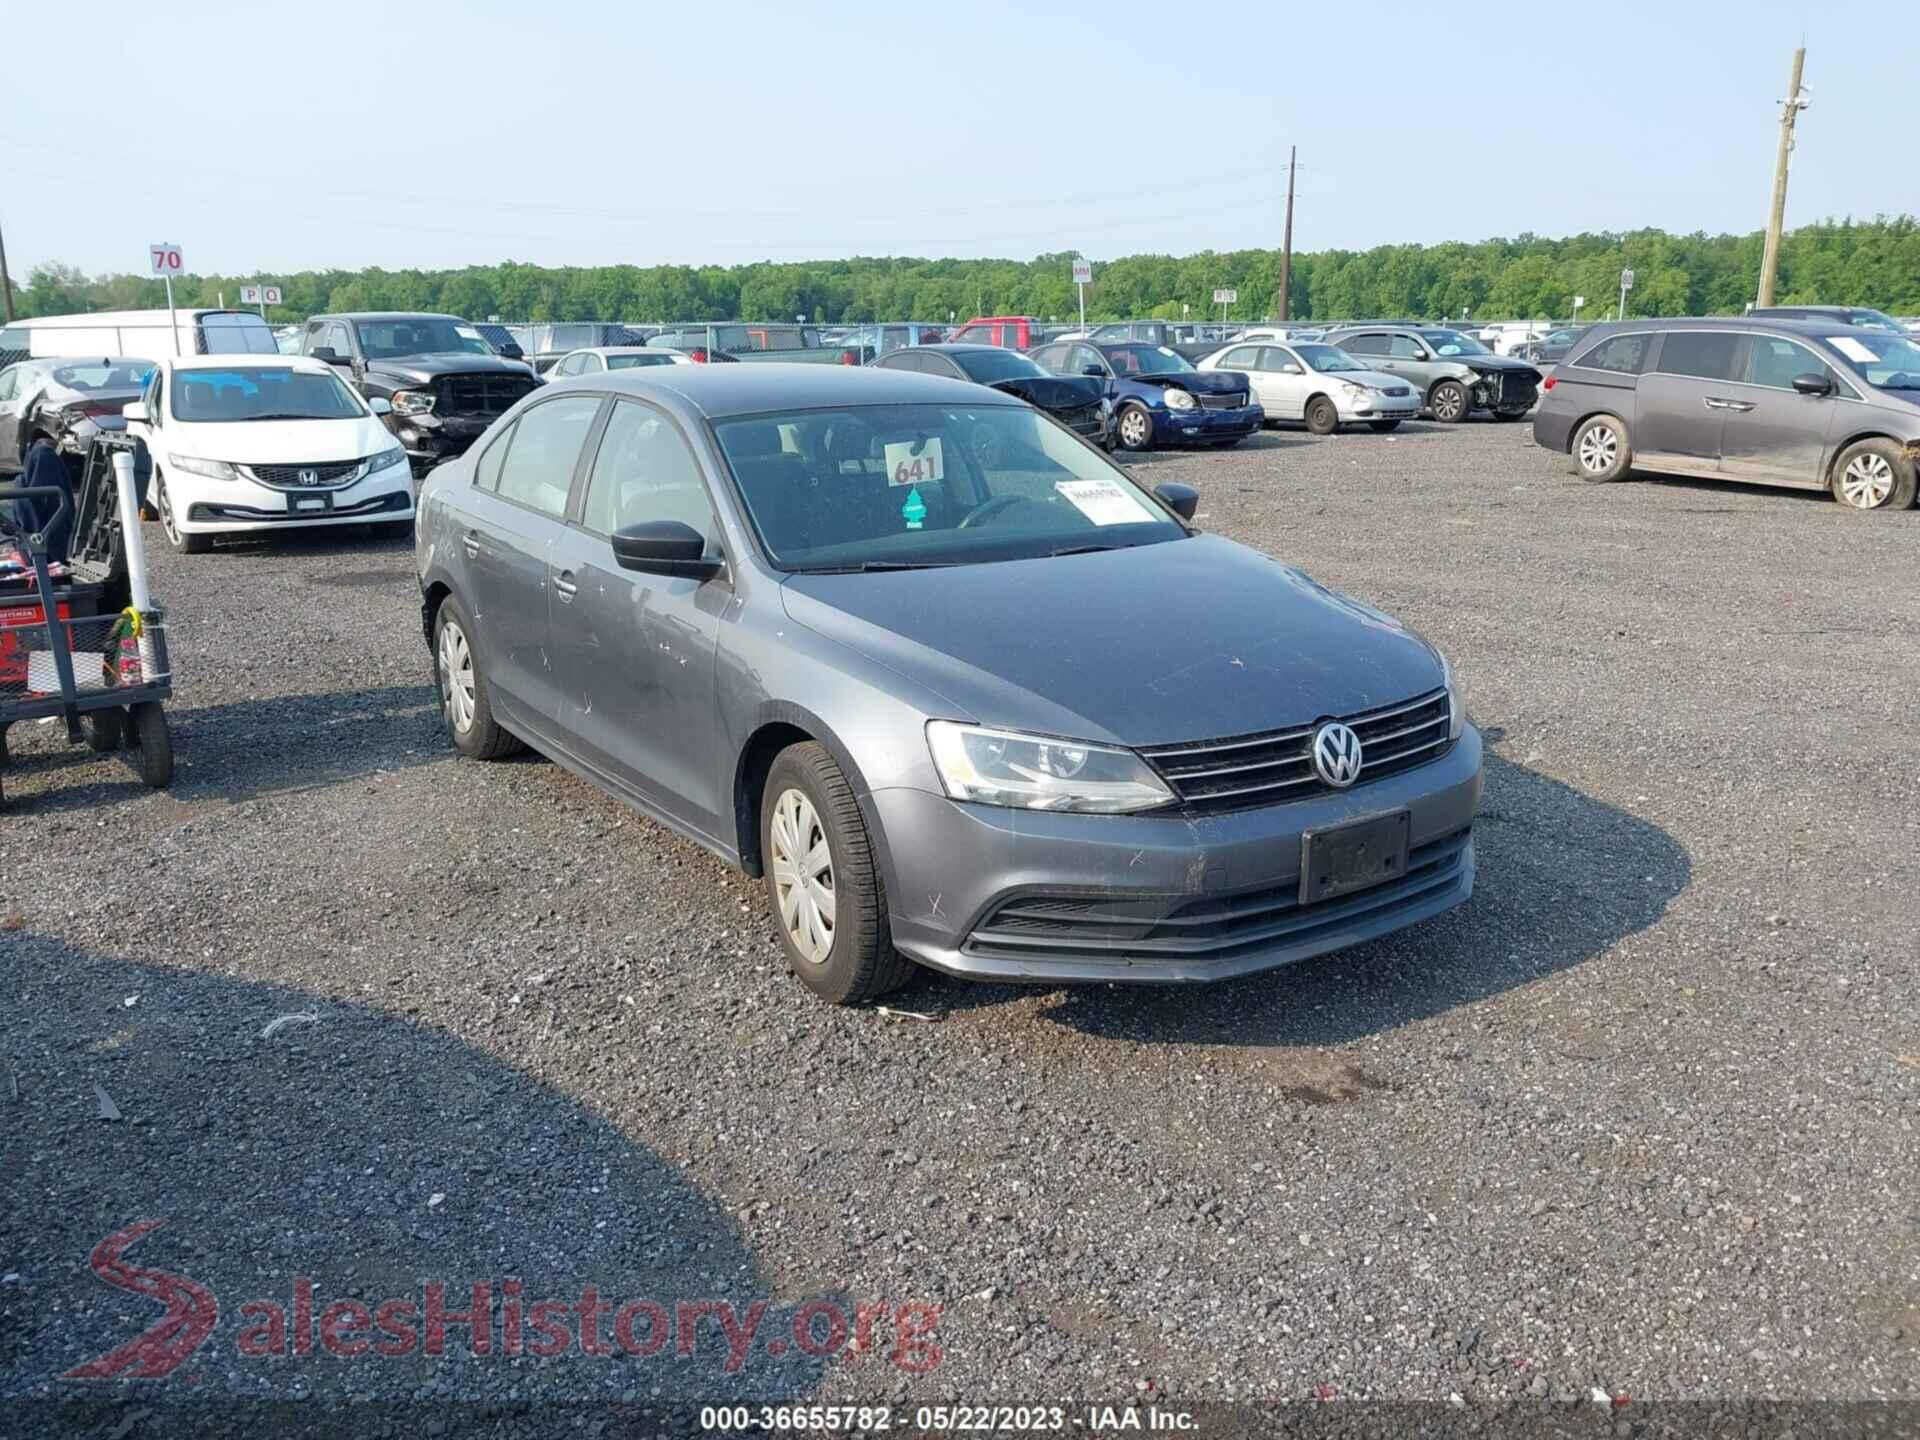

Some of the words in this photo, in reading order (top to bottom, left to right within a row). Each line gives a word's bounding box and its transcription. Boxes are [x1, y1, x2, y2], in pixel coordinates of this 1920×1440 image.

[152, 250, 181, 270] 70
[247, 289, 256, 300] P
[266, 288, 278, 302] Q
[894, 456, 936, 484] 641
